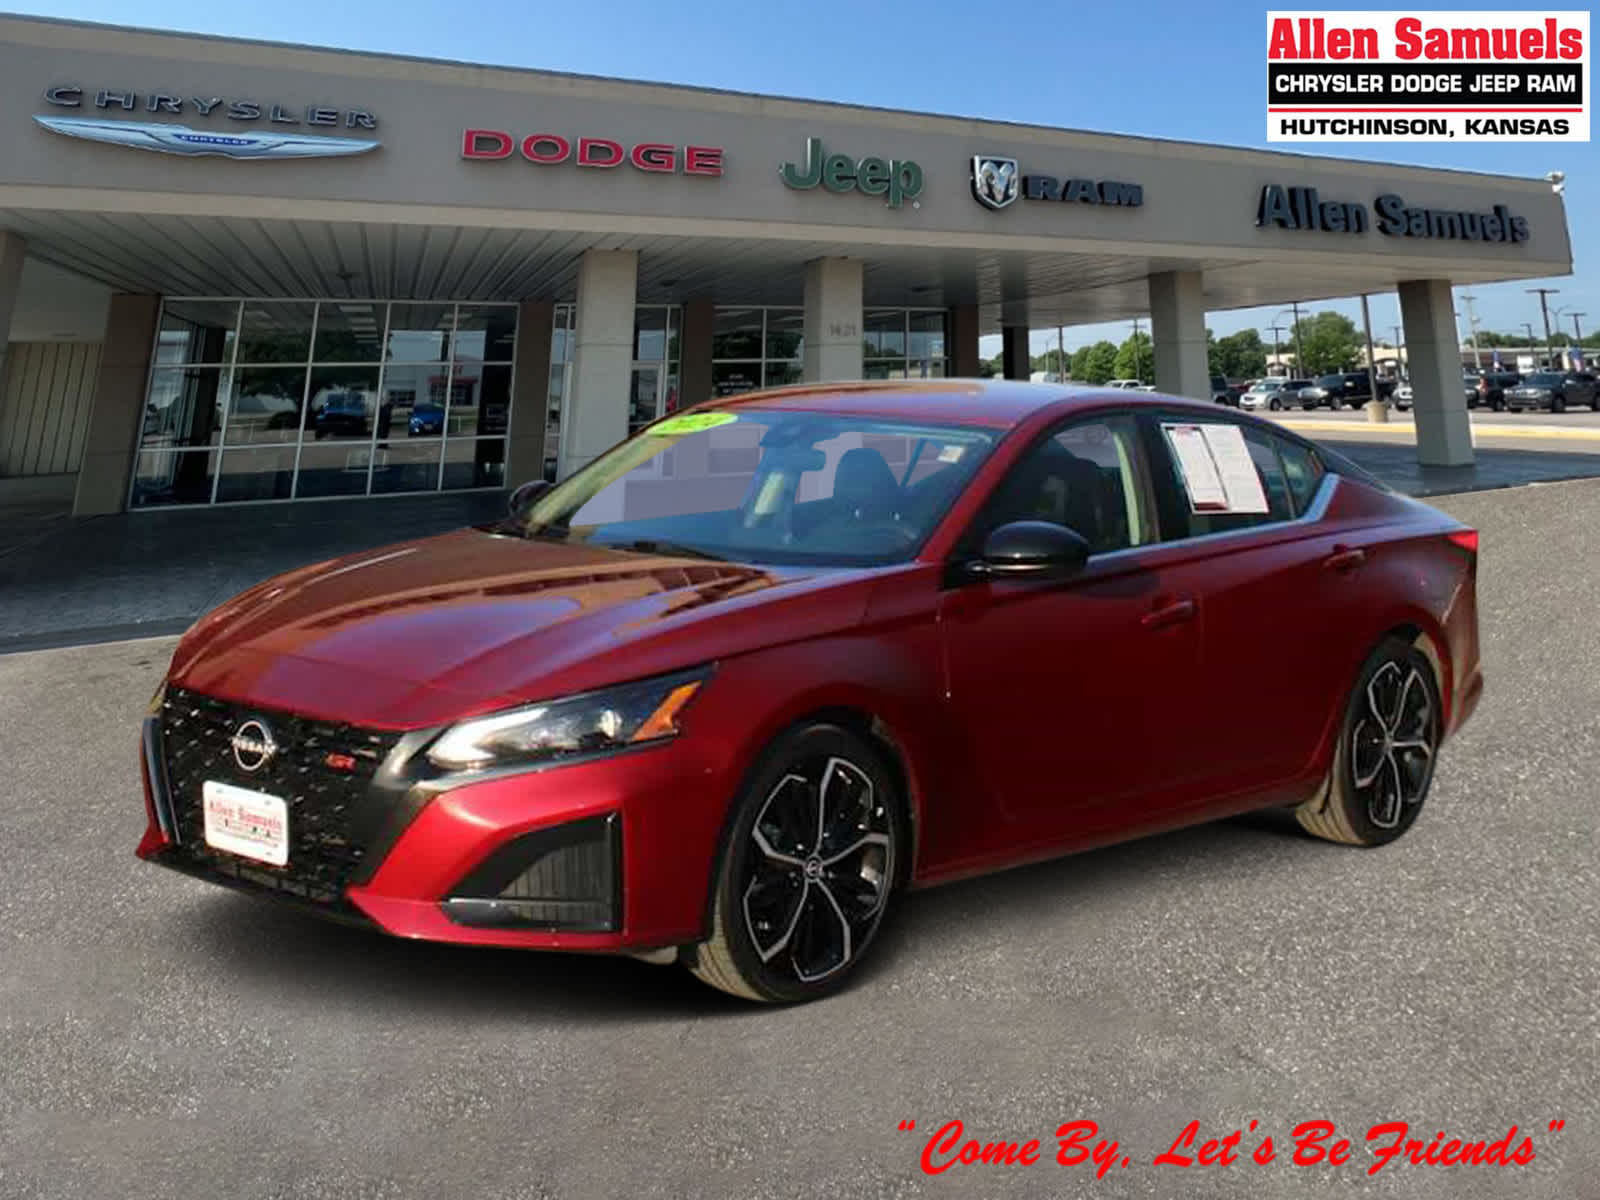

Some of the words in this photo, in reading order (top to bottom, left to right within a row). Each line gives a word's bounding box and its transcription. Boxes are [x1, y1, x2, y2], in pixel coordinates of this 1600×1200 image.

[44, 86, 377, 129] CHRYSLER
[462, 128, 724, 176] DODGE
[779, 135, 923, 209] Jeep
[1022, 175, 1144, 207] RAM
[1255, 184, 1369, 233] Allen
[1373, 193, 1531, 243] Samuels
